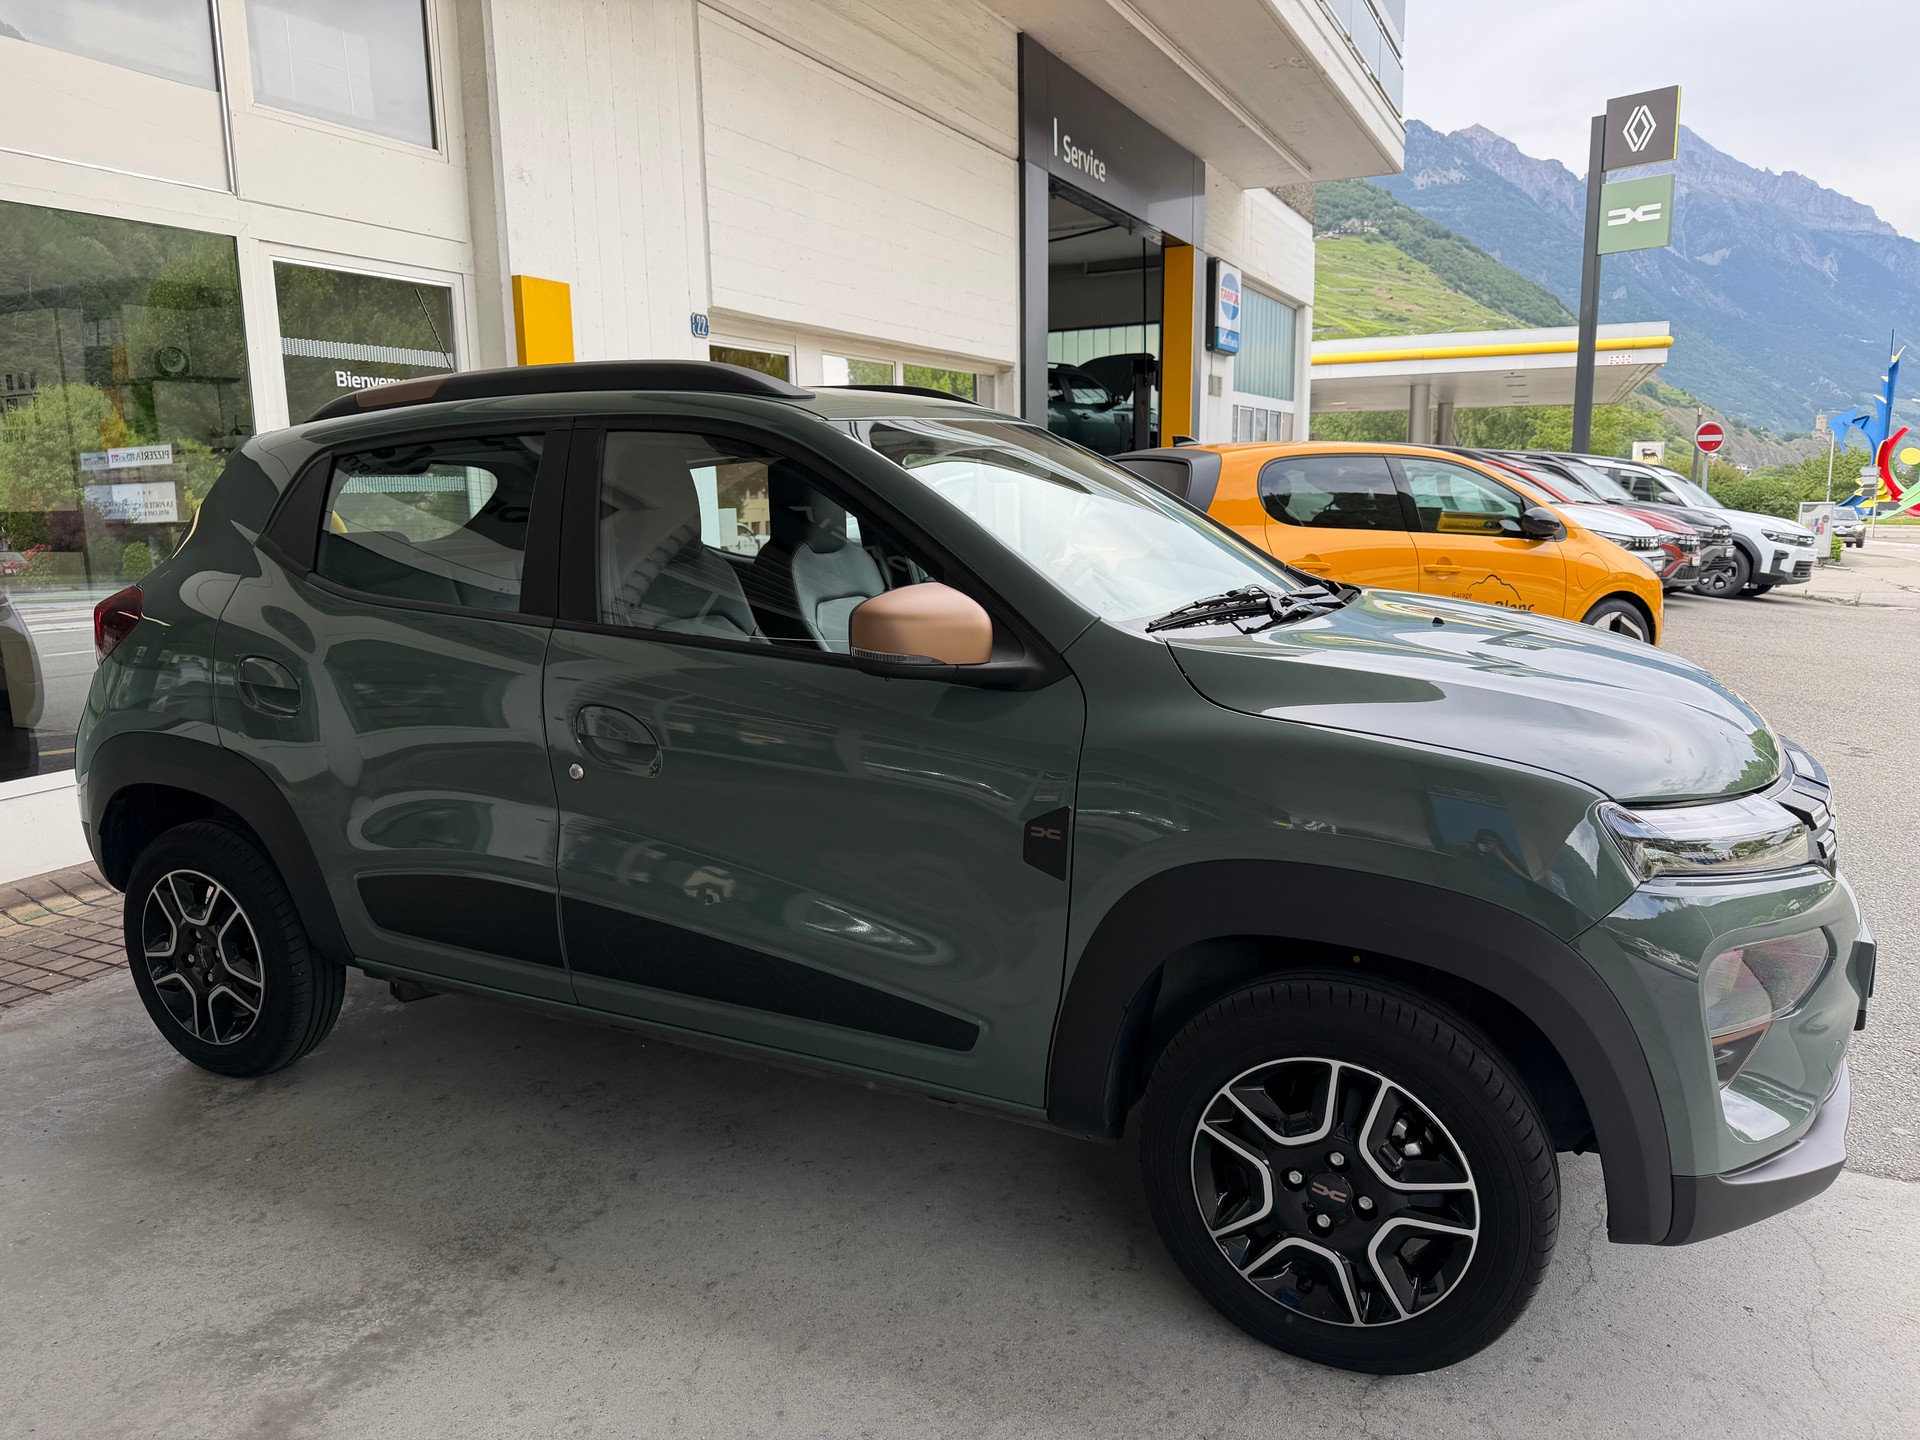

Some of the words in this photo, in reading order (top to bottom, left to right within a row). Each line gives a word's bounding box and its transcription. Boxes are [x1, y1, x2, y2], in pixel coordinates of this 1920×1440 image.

[1063, 134, 1106, 183] Service
[696, 315, 707, 335] 22
[334, 370, 405, 388] Bienve
[1451, 591, 1473, 600] Garage
